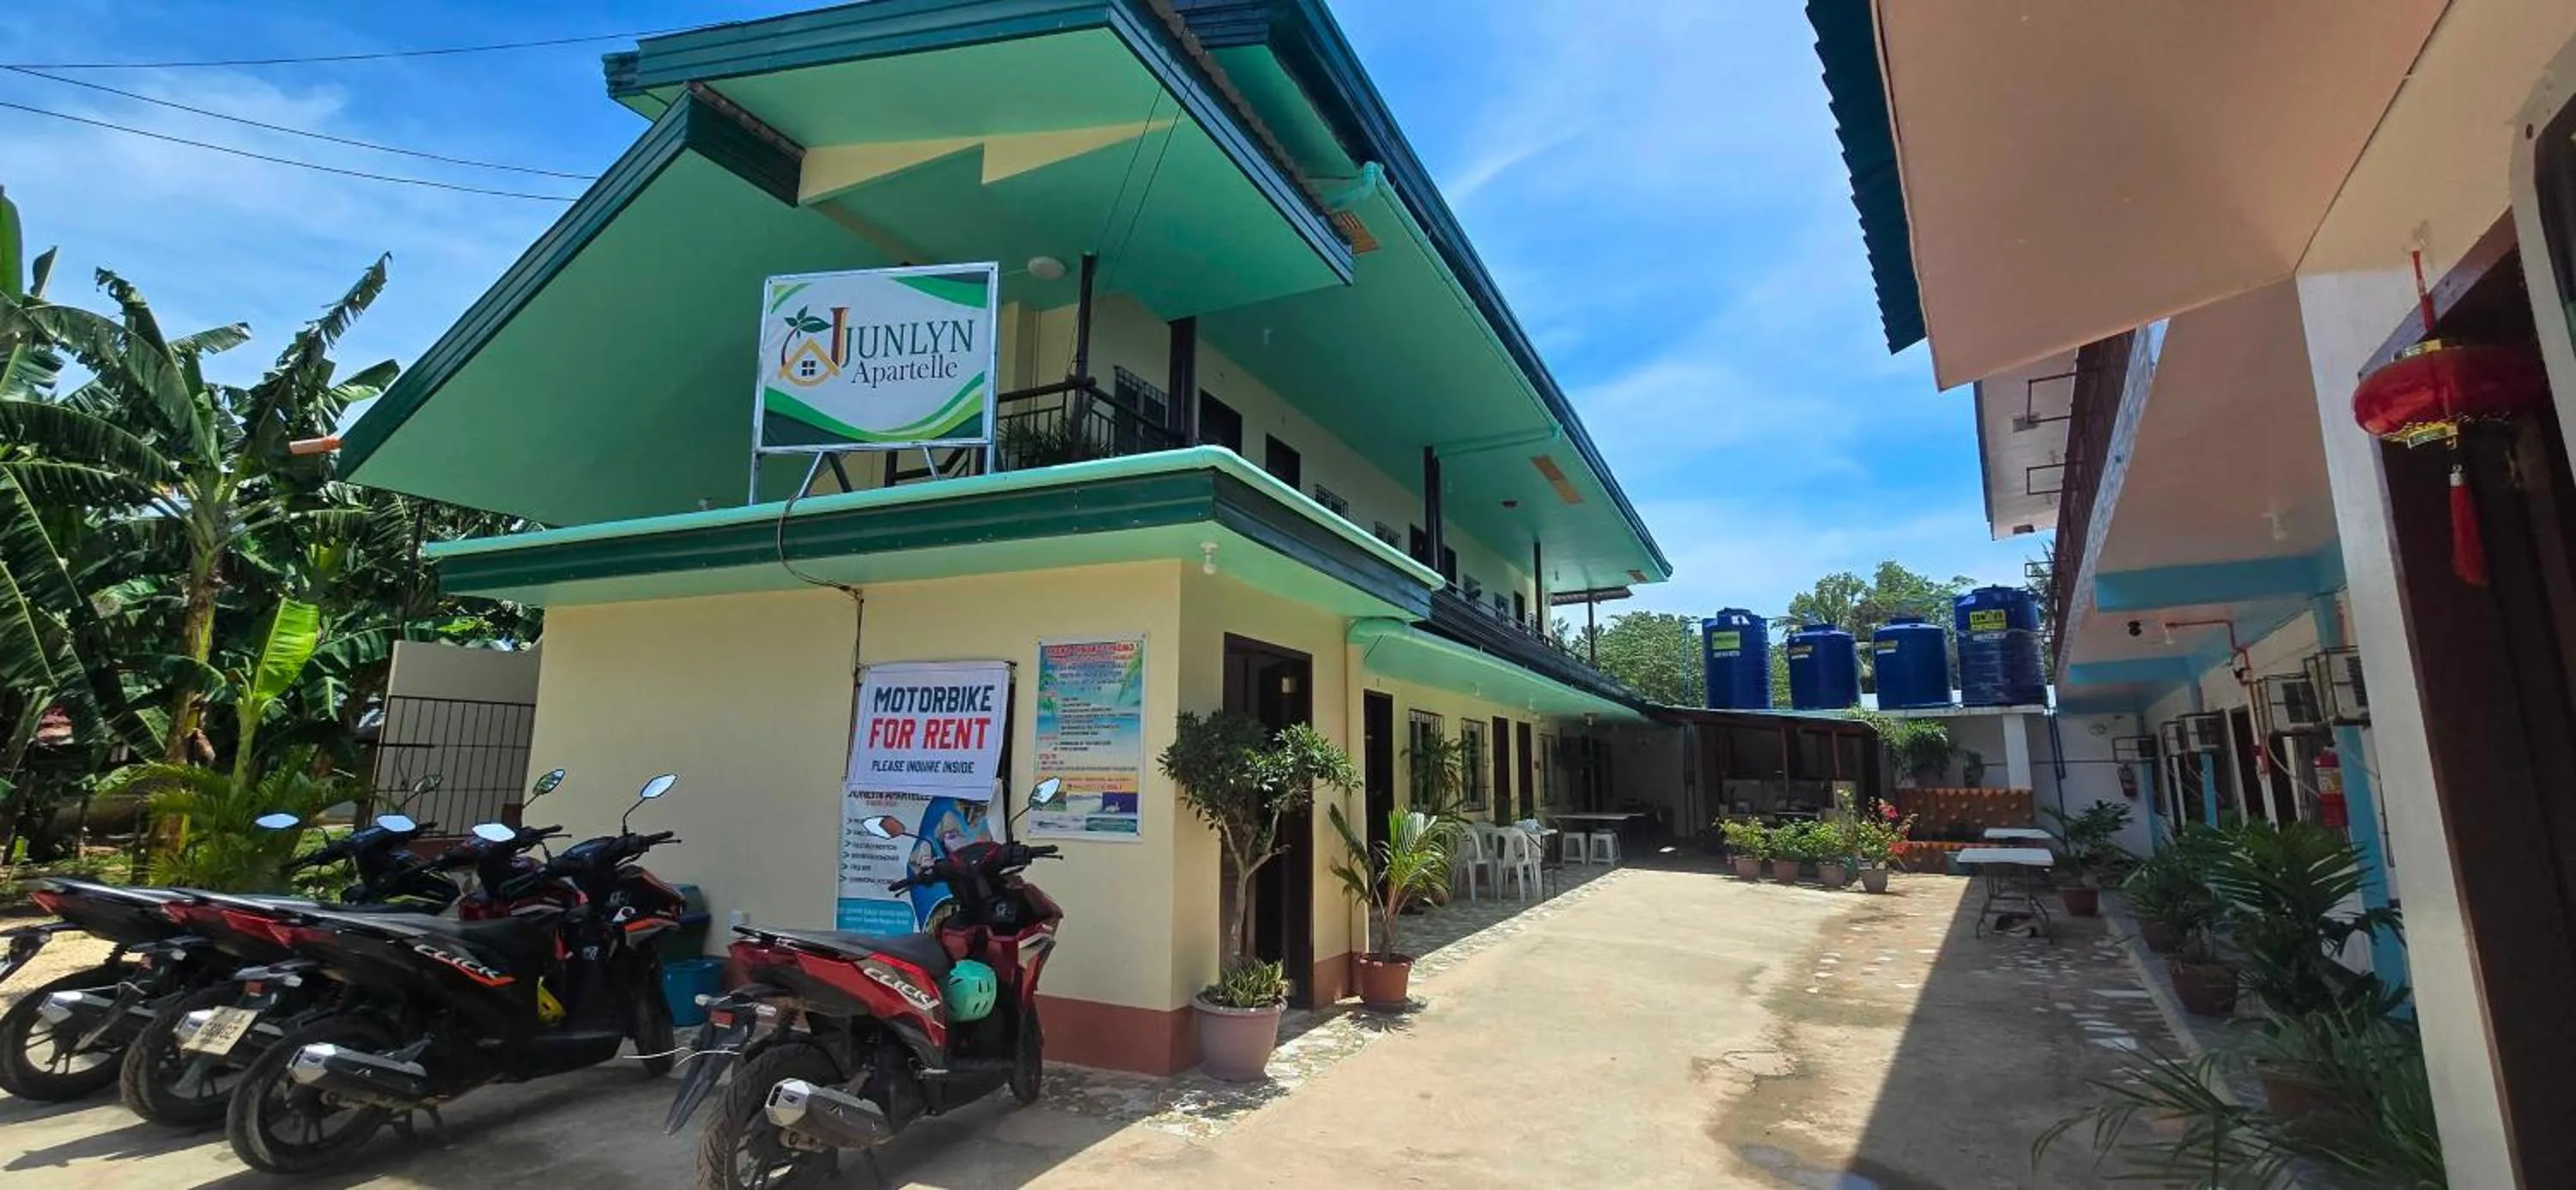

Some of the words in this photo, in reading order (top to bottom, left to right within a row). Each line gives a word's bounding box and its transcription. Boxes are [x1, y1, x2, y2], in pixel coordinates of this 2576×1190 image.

[841, 319, 975, 367] JUNLYN
[852, 354, 958, 388] Apartelle
[873, 684, 995, 713] MOTORBIKE
[868, 718, 916, 750] FOR
[922, 718, 992, 750] RENT
[872, 760, 905, 772] PLEASE
[906, 760, 941, 773] INQUIRE
[942, 761, 975, 773] INSIDE
[414, 944, 501, 979] CLICK
[864, 968, 930, 1005] CLICK
